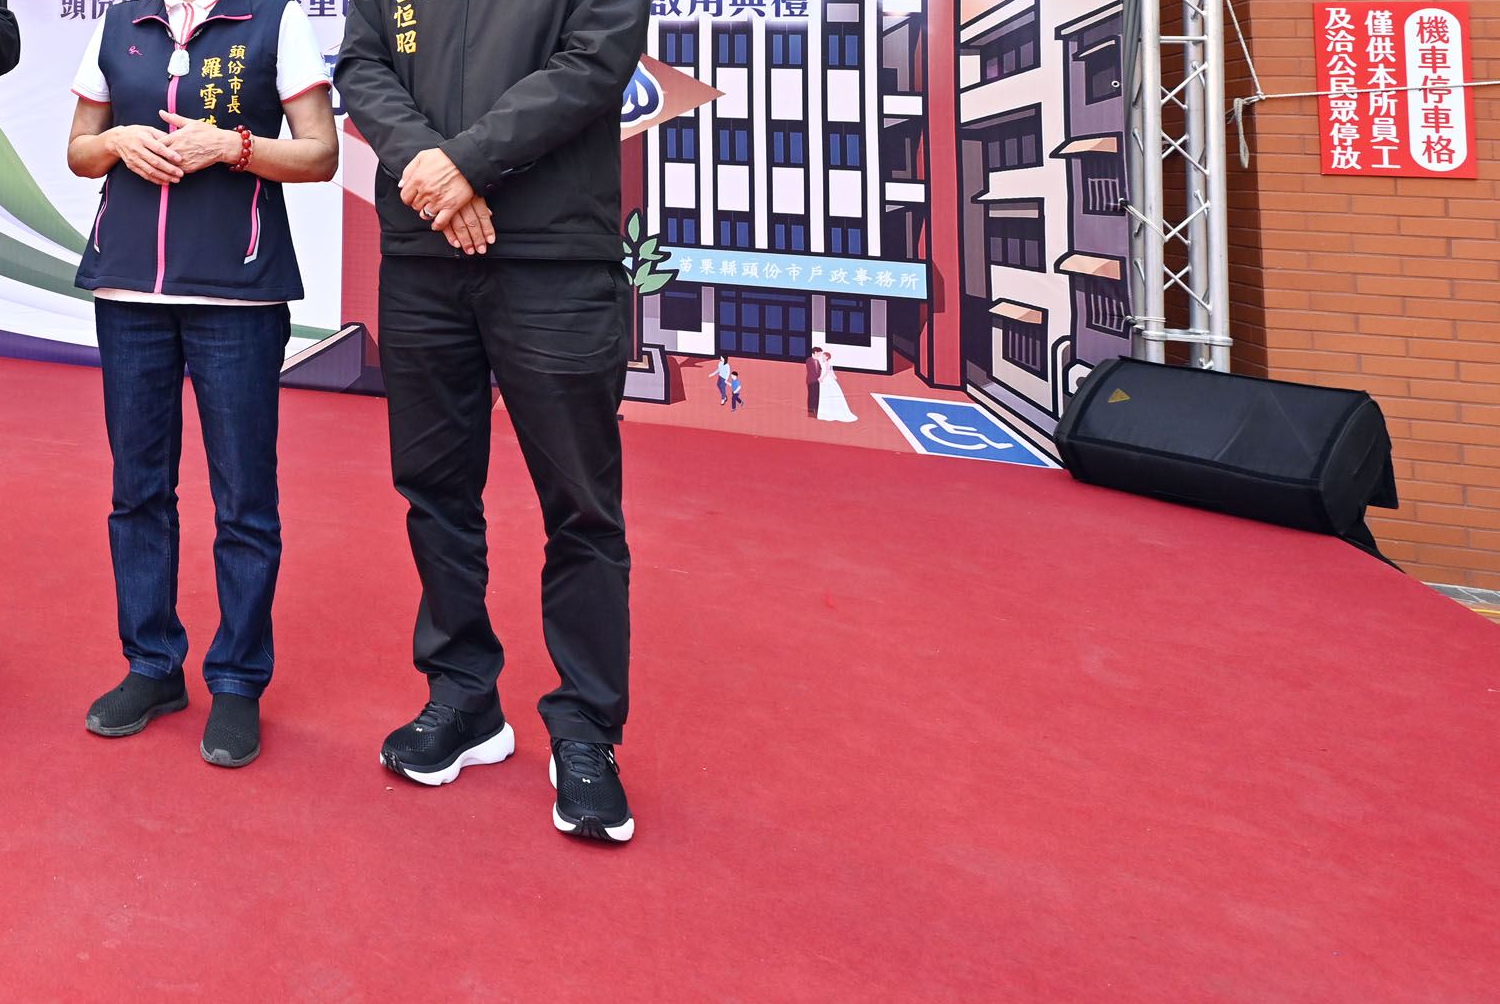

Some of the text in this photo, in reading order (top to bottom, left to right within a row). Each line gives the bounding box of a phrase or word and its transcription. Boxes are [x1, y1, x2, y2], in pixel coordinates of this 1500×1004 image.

[227, 44, 246, 114] 頭份市長
[1325, 7, 1362, 171] 及洽公民眾停放
[1365, 9, 1401, 170] 僅供本所員工
[1416, 15, 1456, 166] 機車停車格
